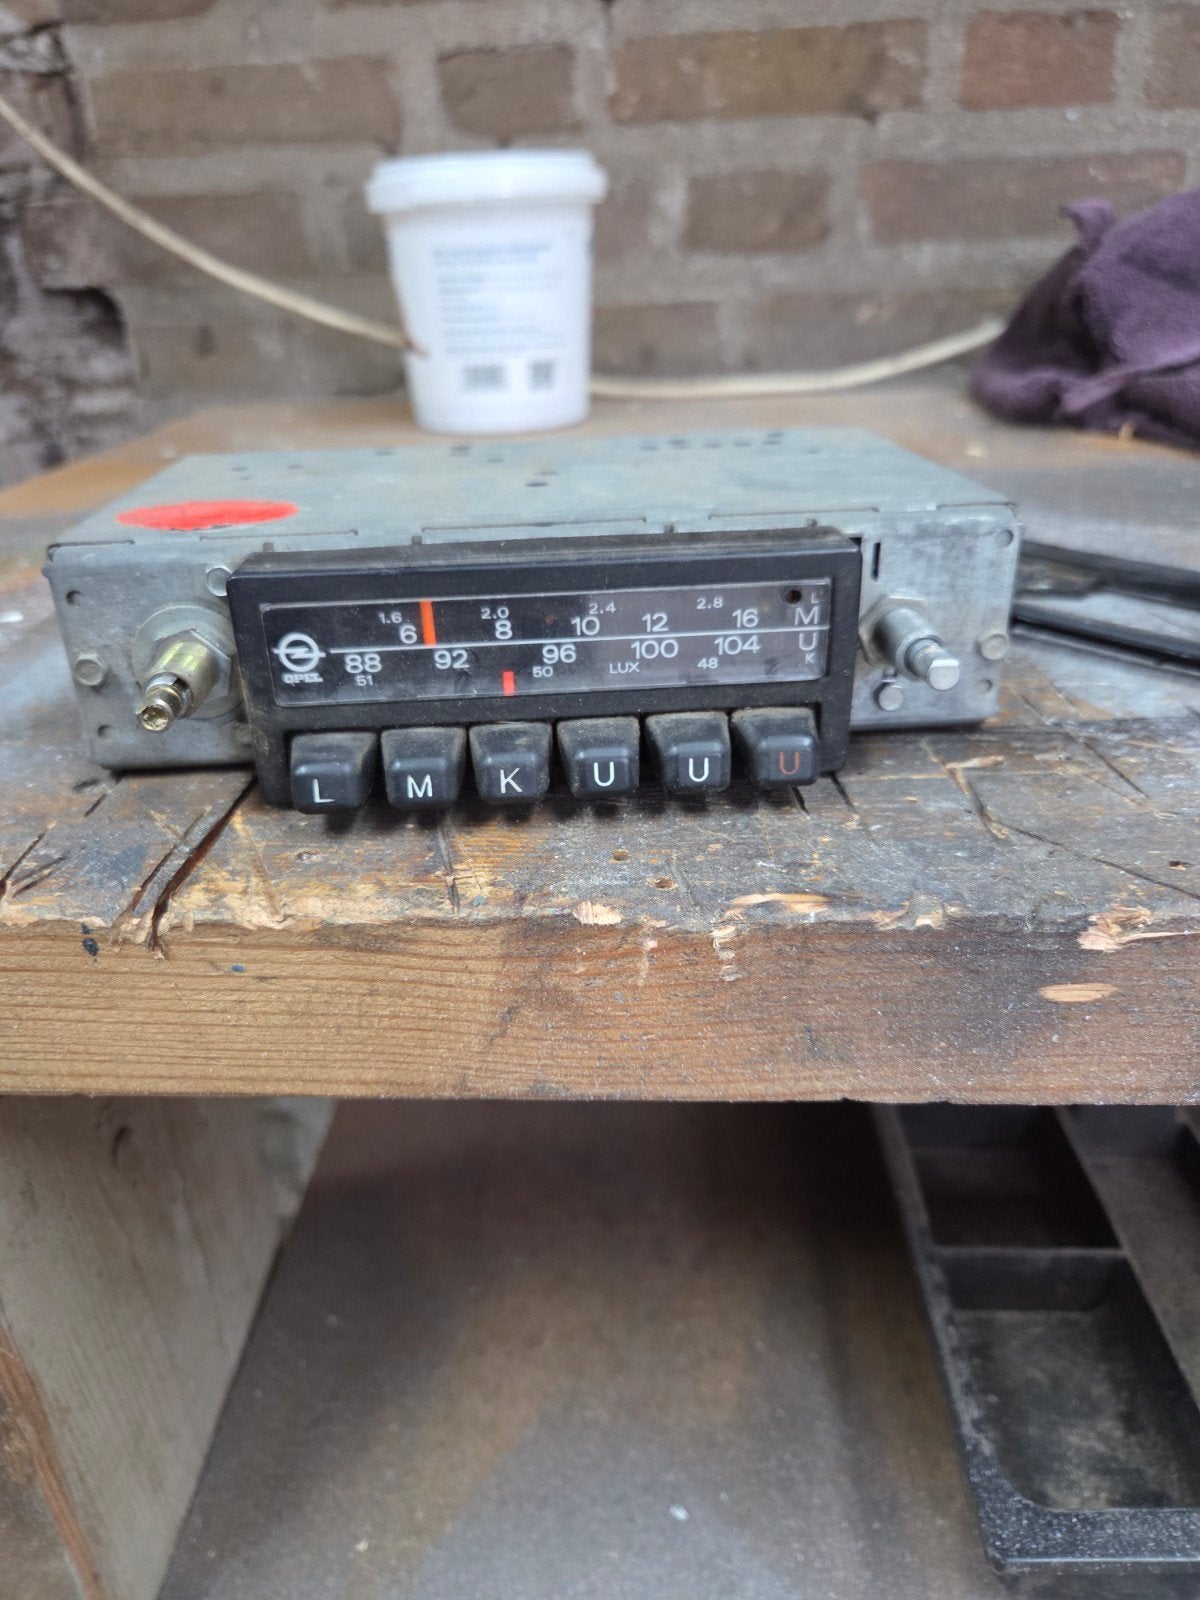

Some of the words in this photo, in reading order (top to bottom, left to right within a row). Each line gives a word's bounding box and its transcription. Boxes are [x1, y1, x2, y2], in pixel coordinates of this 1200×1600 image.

[480, 606, 509, 620] 2.0
[588, 602, 616, 615] 2.4
[696, 597, 724, 610] 2.8
[810, 592, 819, 604] L
[399, 624, 418, 644] 6
[494, 620, 513, 640] 8
[570, 616, 601, 636] 10
[641, 612, 670, 633] 12
[731, 608, 759, 628] 16
[793, 606, 820, 625] M
[344, 653, 383, 674] 88
[434, 649, 470, 669] 92
[542, 644, 577, 664] 96
[631, 639, 679, 659] 100
[713, 635, 760, 656] 104
[798, 632, 818, 651] U
[282, 672, 323, 684] OPEL
[532, 666, 554, 678] 50
[609, 662, 640, 674] LUX
[697, 657, 719, 669] 48
[592, 761, 616, 787] U
[687, 757, 710, 782] U
[777, 750, 801, 775] U
[311, 778, 335, 803] L
[406, 774, 434, 798] M
